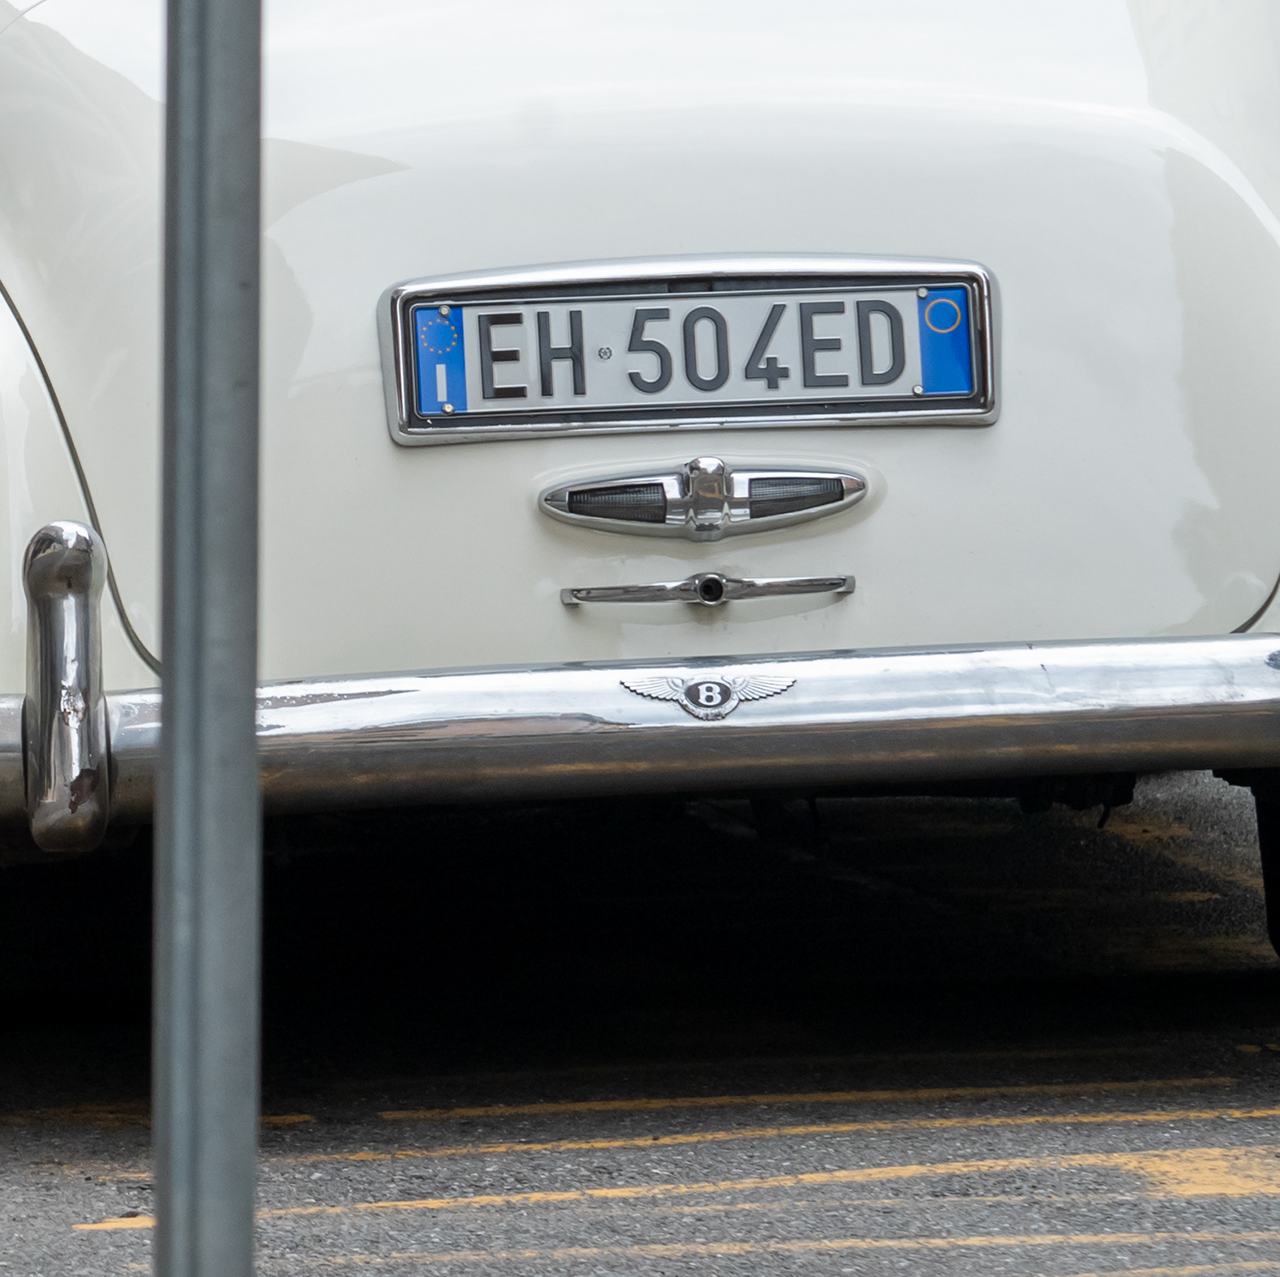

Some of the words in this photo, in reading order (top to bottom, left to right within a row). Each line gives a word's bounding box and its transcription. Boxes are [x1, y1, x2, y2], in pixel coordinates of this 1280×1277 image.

[477, 309, 586, 399] EH
[627, 299, 906, 394] 504ED
[698, 682, 722, 706] B
